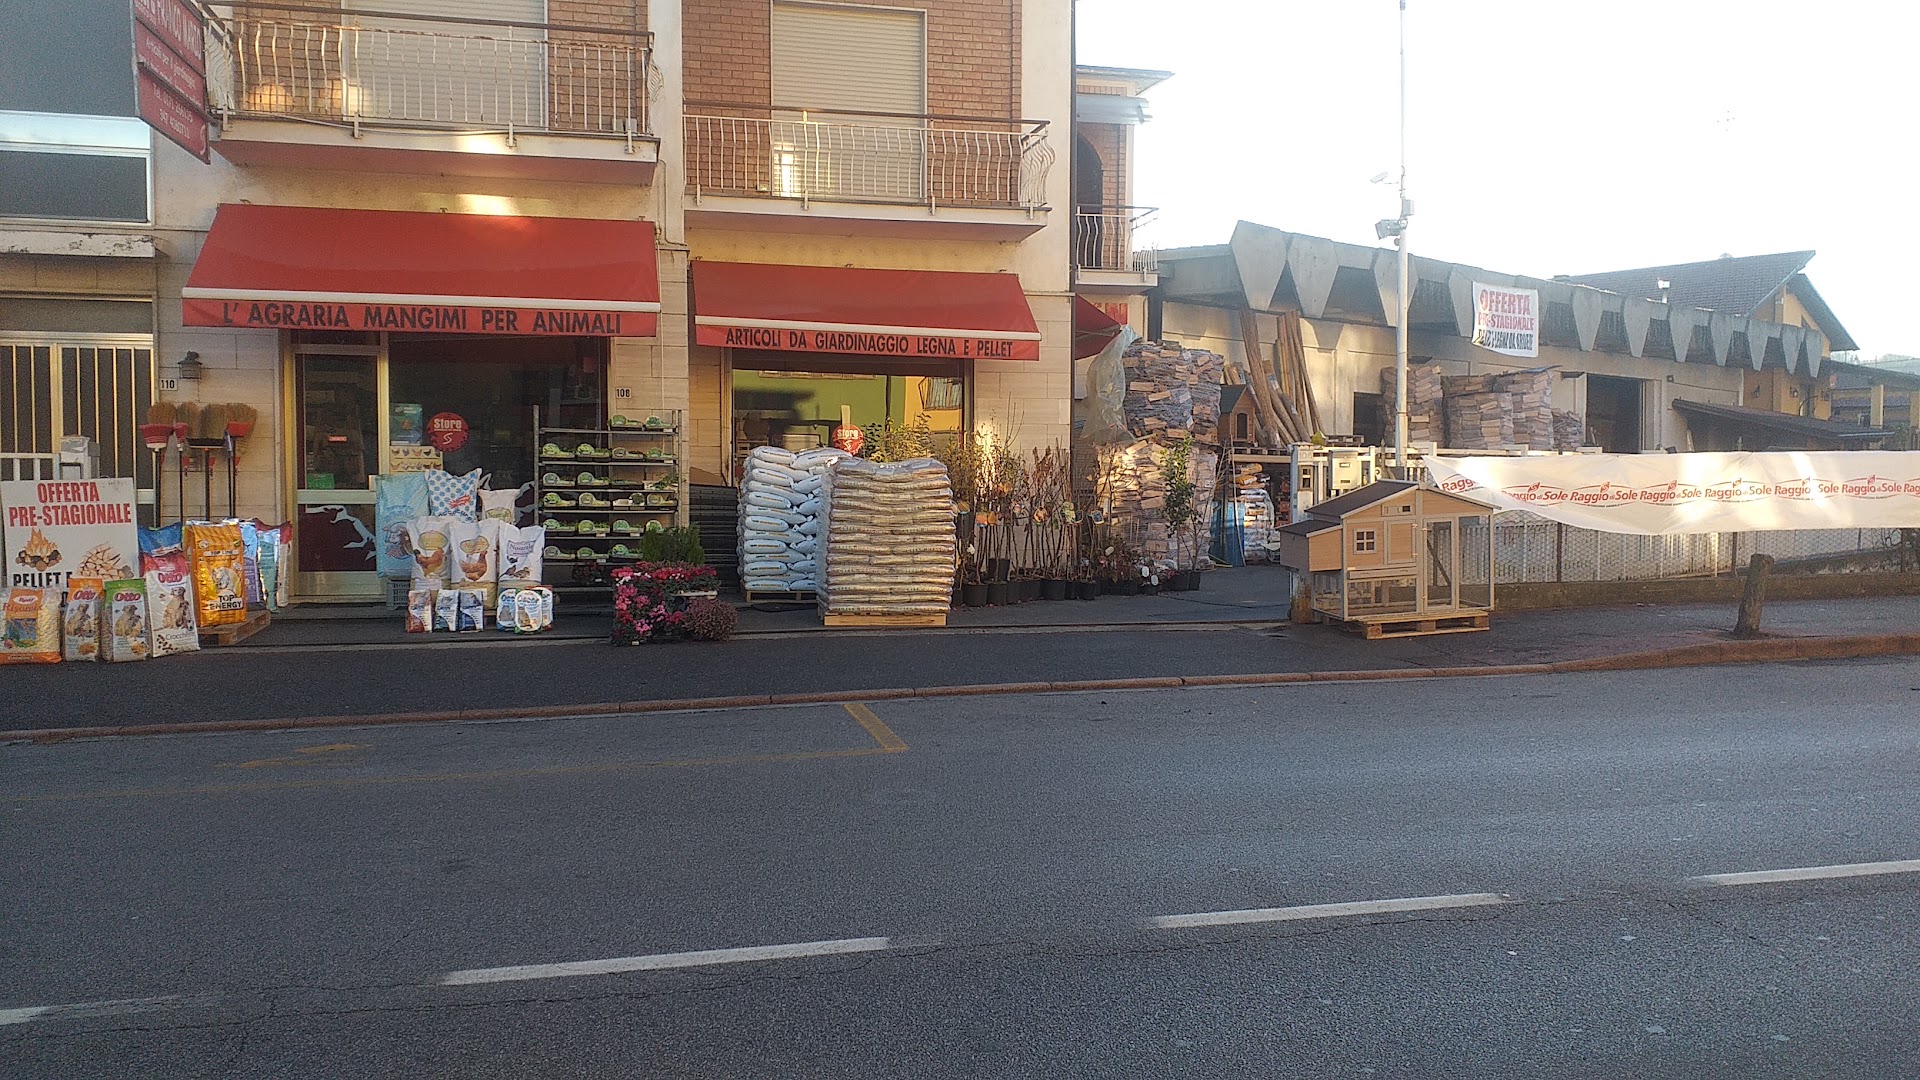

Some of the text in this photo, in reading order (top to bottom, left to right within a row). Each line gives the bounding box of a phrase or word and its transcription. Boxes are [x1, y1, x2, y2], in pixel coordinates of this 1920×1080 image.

[1479, 289, 1531, 316] OFFERTA
[247, 303, 350, 328] AGRARIA
[363, 306, 467, 331] MANGIMI
[481, 310, 519, 332] PER
[532, 311, 621, 335] ANIMALI
[725, 328, 1013, 358] ARTICOLI DA GIARDINAGGIO LEGNA E PELLET
[161, 379, 175, 389] 110
[616, 388, 631, 398] 108
[433, 418, 462, 429] Store
[36, 481, 101, 504] OFFERTA
[1441, 479, 1475, 492] Ragg
[1704, 488, 1742, 500] Raggio
[1748, 484, 1772, 495] Sole
[1774, 483, 1840, 497] Raggio Sole
[1841, 483, 1877, 496] Raggio
[1881, 482, 1902, 493] Sole
[1542, 490, 1569, 501] Sole
[1569, 491, 1609, 504] Raggio
[1614, 489, 1638, 501] Sole
[1639, 490, 1676, 503] Raggio
[1681, 488, 1702, 499] Sole
[8, 503, 132, 527] PRE-STAGIONALE
[13, 571, 62, 588] PELLET
[209, 601, 242, 610] ENERGY
[218, 594, 235, 603] TOP
